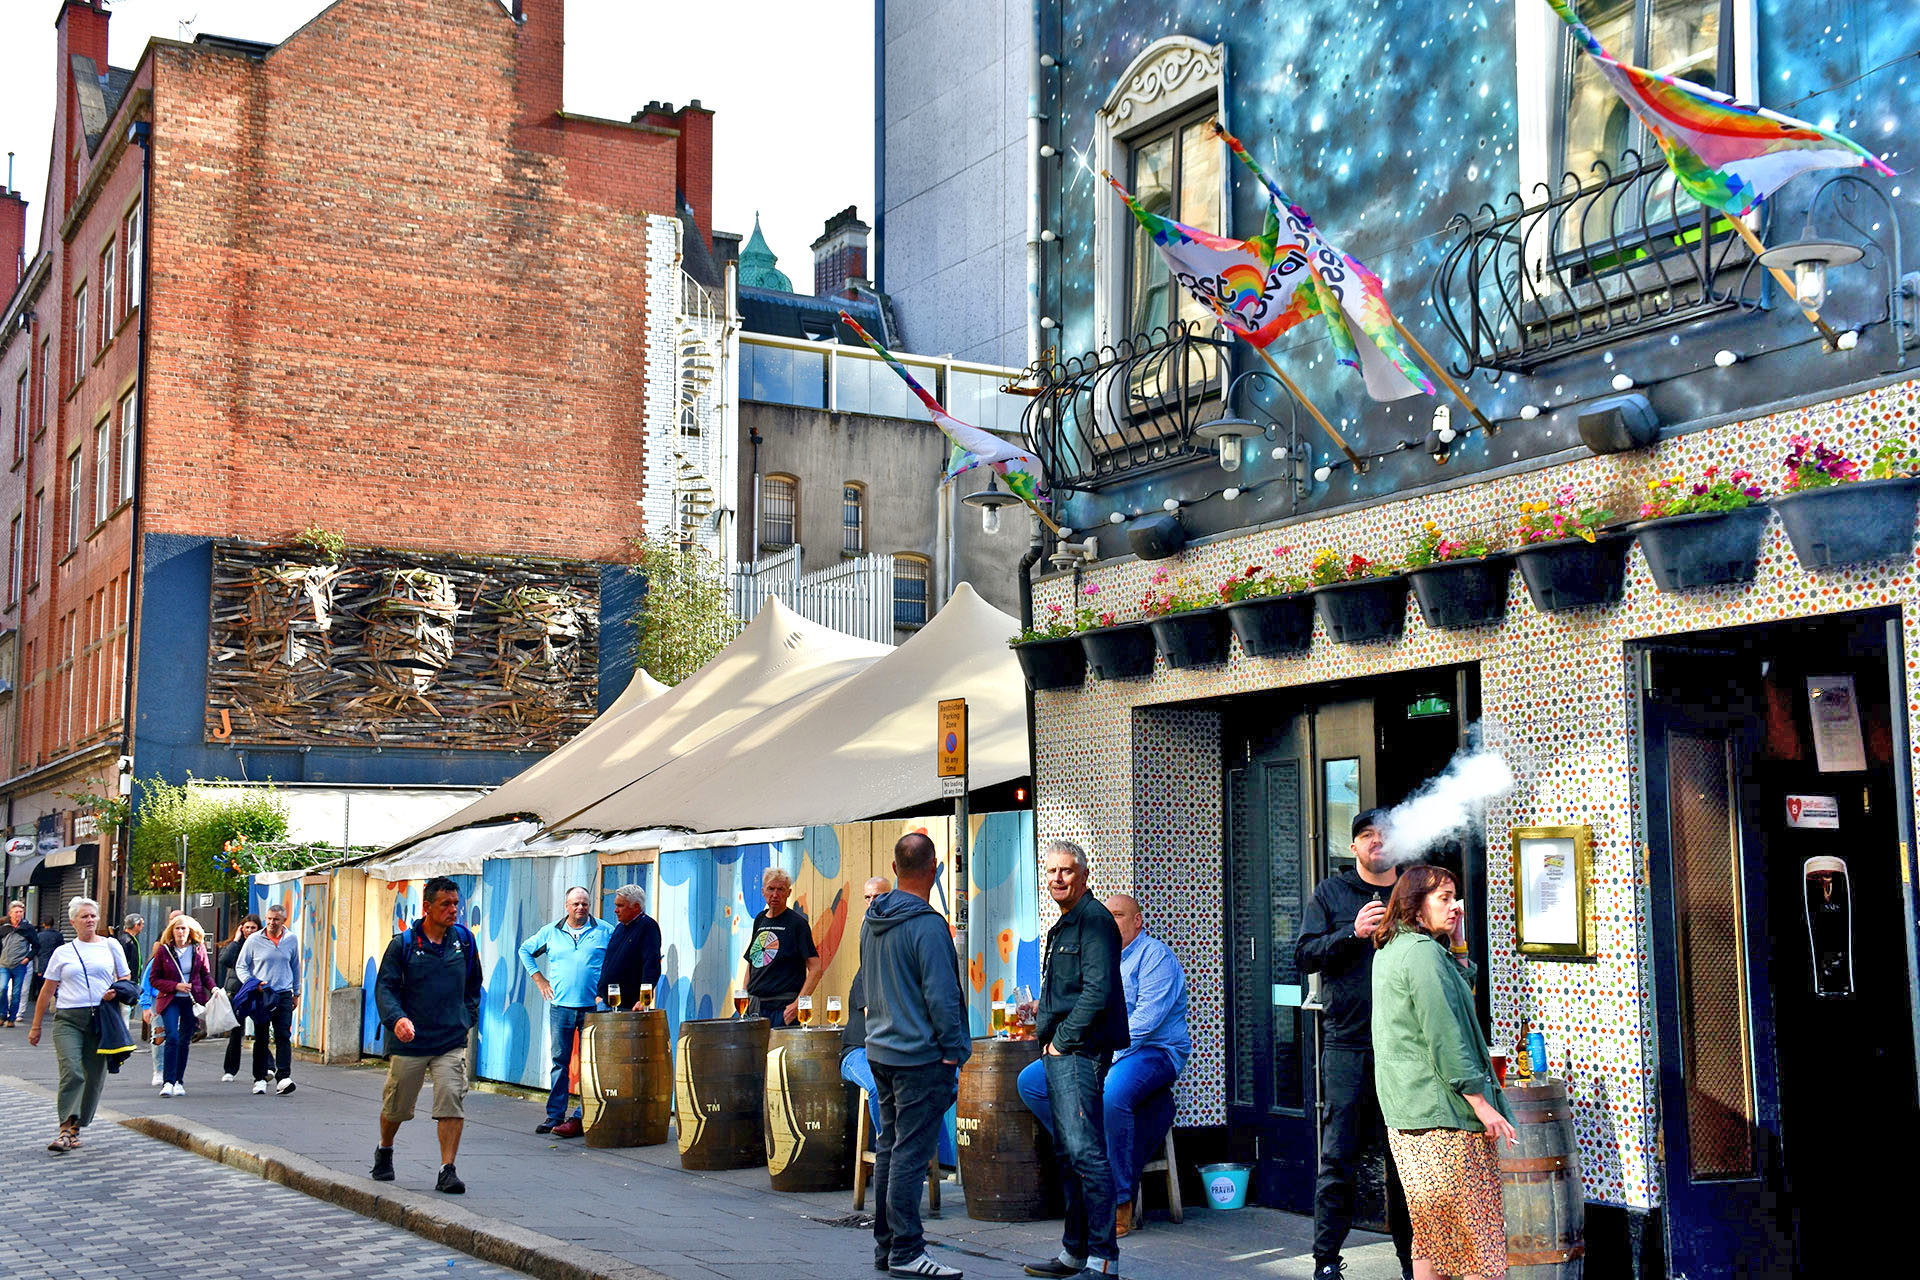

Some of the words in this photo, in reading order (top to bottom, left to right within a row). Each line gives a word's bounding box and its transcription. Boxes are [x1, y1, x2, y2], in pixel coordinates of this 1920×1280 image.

[940, 703, 963, 712] Restricted
[943, 712, 960, 721] Parking
[213, 708, 232, 739] J
[946, 720, 957, 729] Zone
[951, 757, 959, 766] any
[946, 764, 956, 773] time
[950, 779, 963, 789] loading
[605, 1089, 618, 1097] TM
[706, 1104, 721, 1112] TM
[805, 1121, 820, 1130] TM
[1211, 1184, 1235, 1194] PRAVHA
